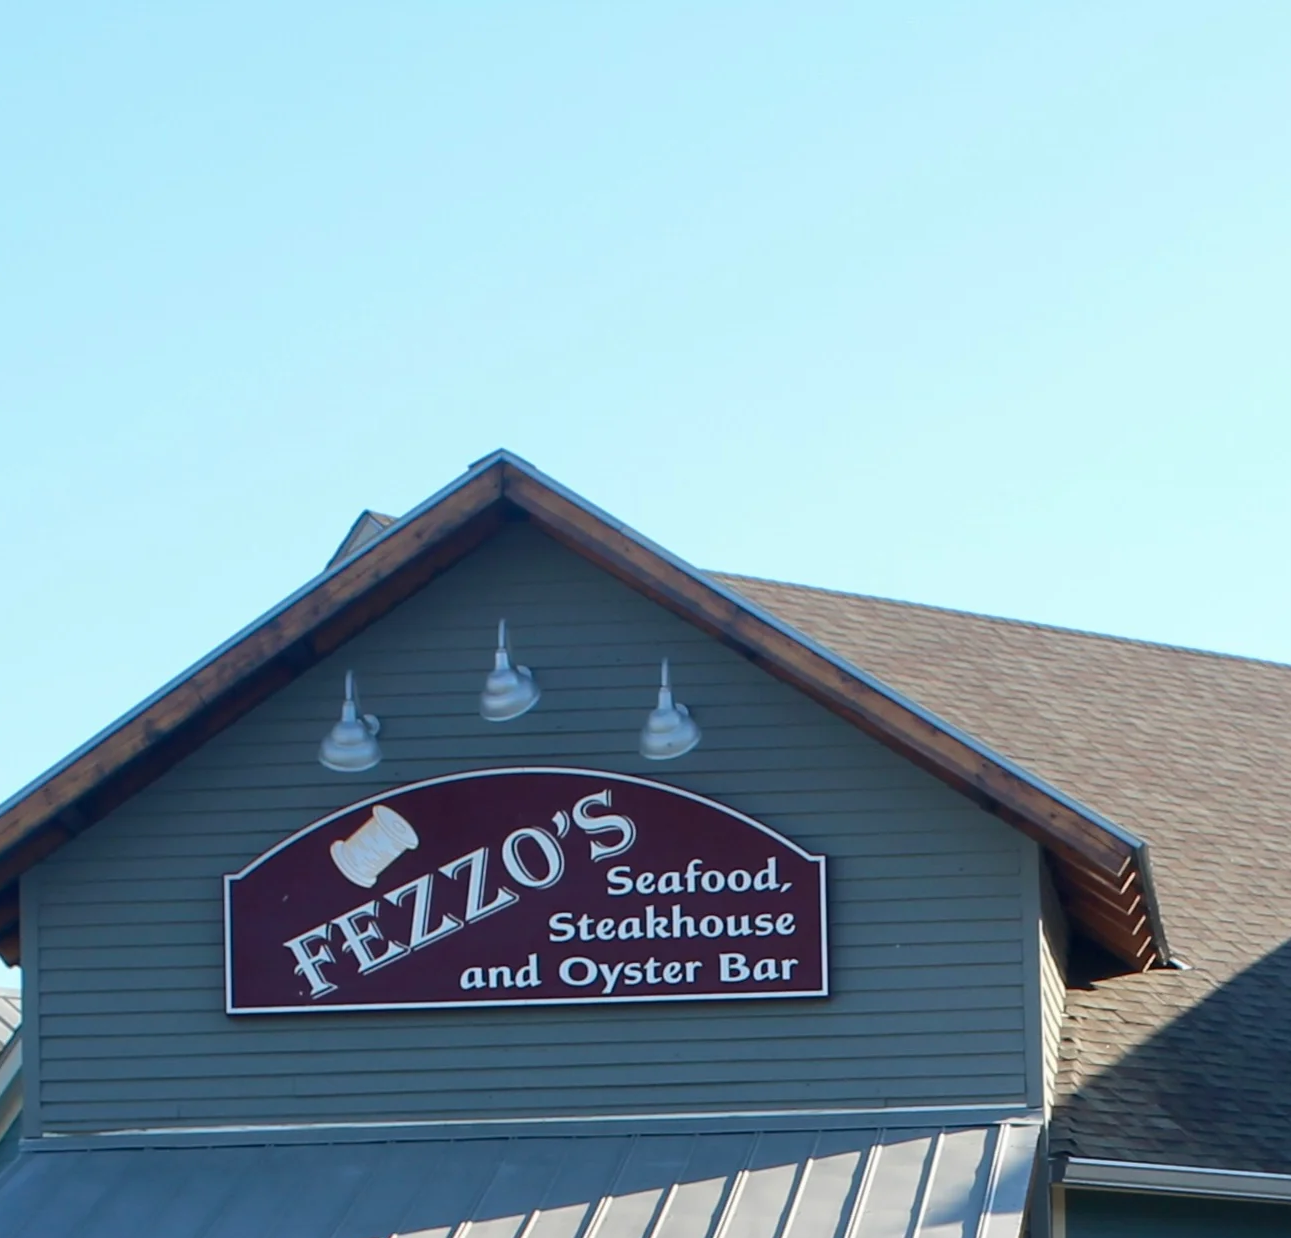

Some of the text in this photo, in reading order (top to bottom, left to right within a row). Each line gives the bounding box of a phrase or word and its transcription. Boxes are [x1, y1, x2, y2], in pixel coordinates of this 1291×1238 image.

[283, 790, 636, 999] FEZZO'S
[606, 857, 793, 896] Seafood,
[548, 906, 797, 943] Steakhouse
[459, 953, 799, 994] and Oyster Bar
